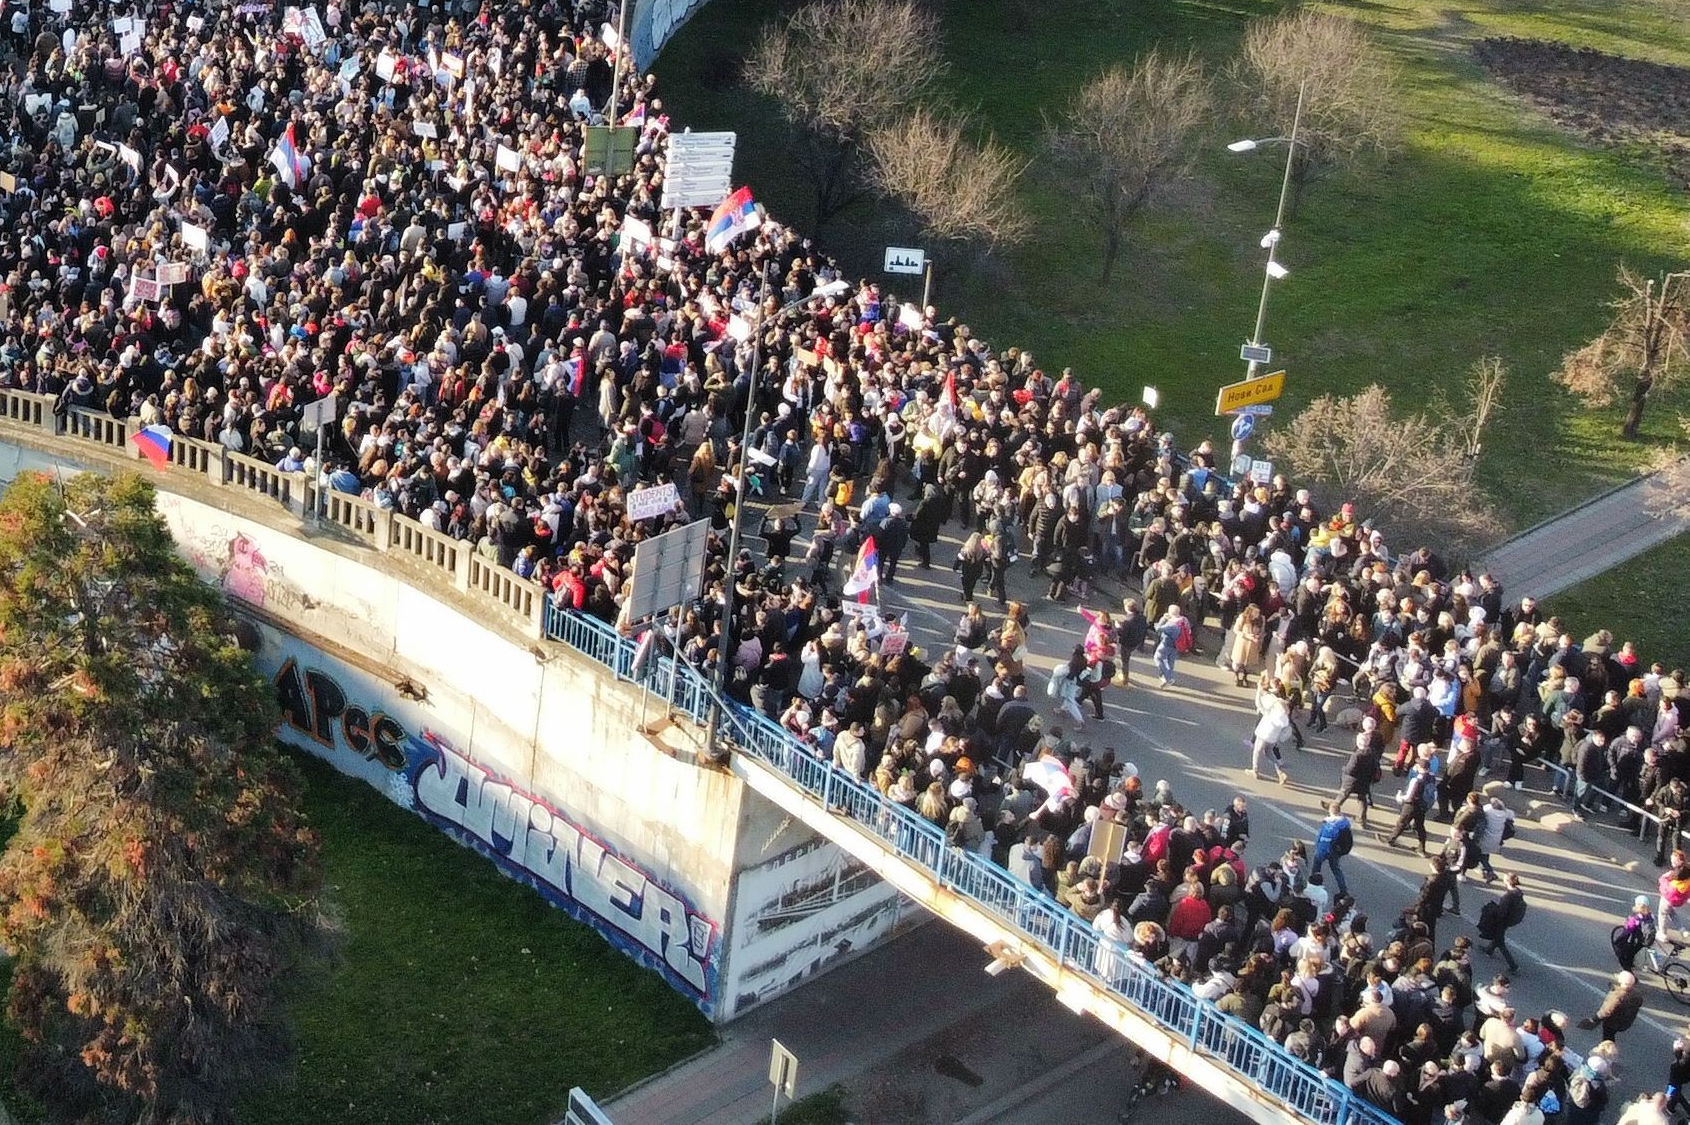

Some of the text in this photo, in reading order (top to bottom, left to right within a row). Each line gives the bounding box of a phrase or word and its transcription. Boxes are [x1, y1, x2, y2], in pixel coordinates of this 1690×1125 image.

[1227, 383, 1273, 404] Нови Сад
[630, 486, 673, 504] STUDENTS
